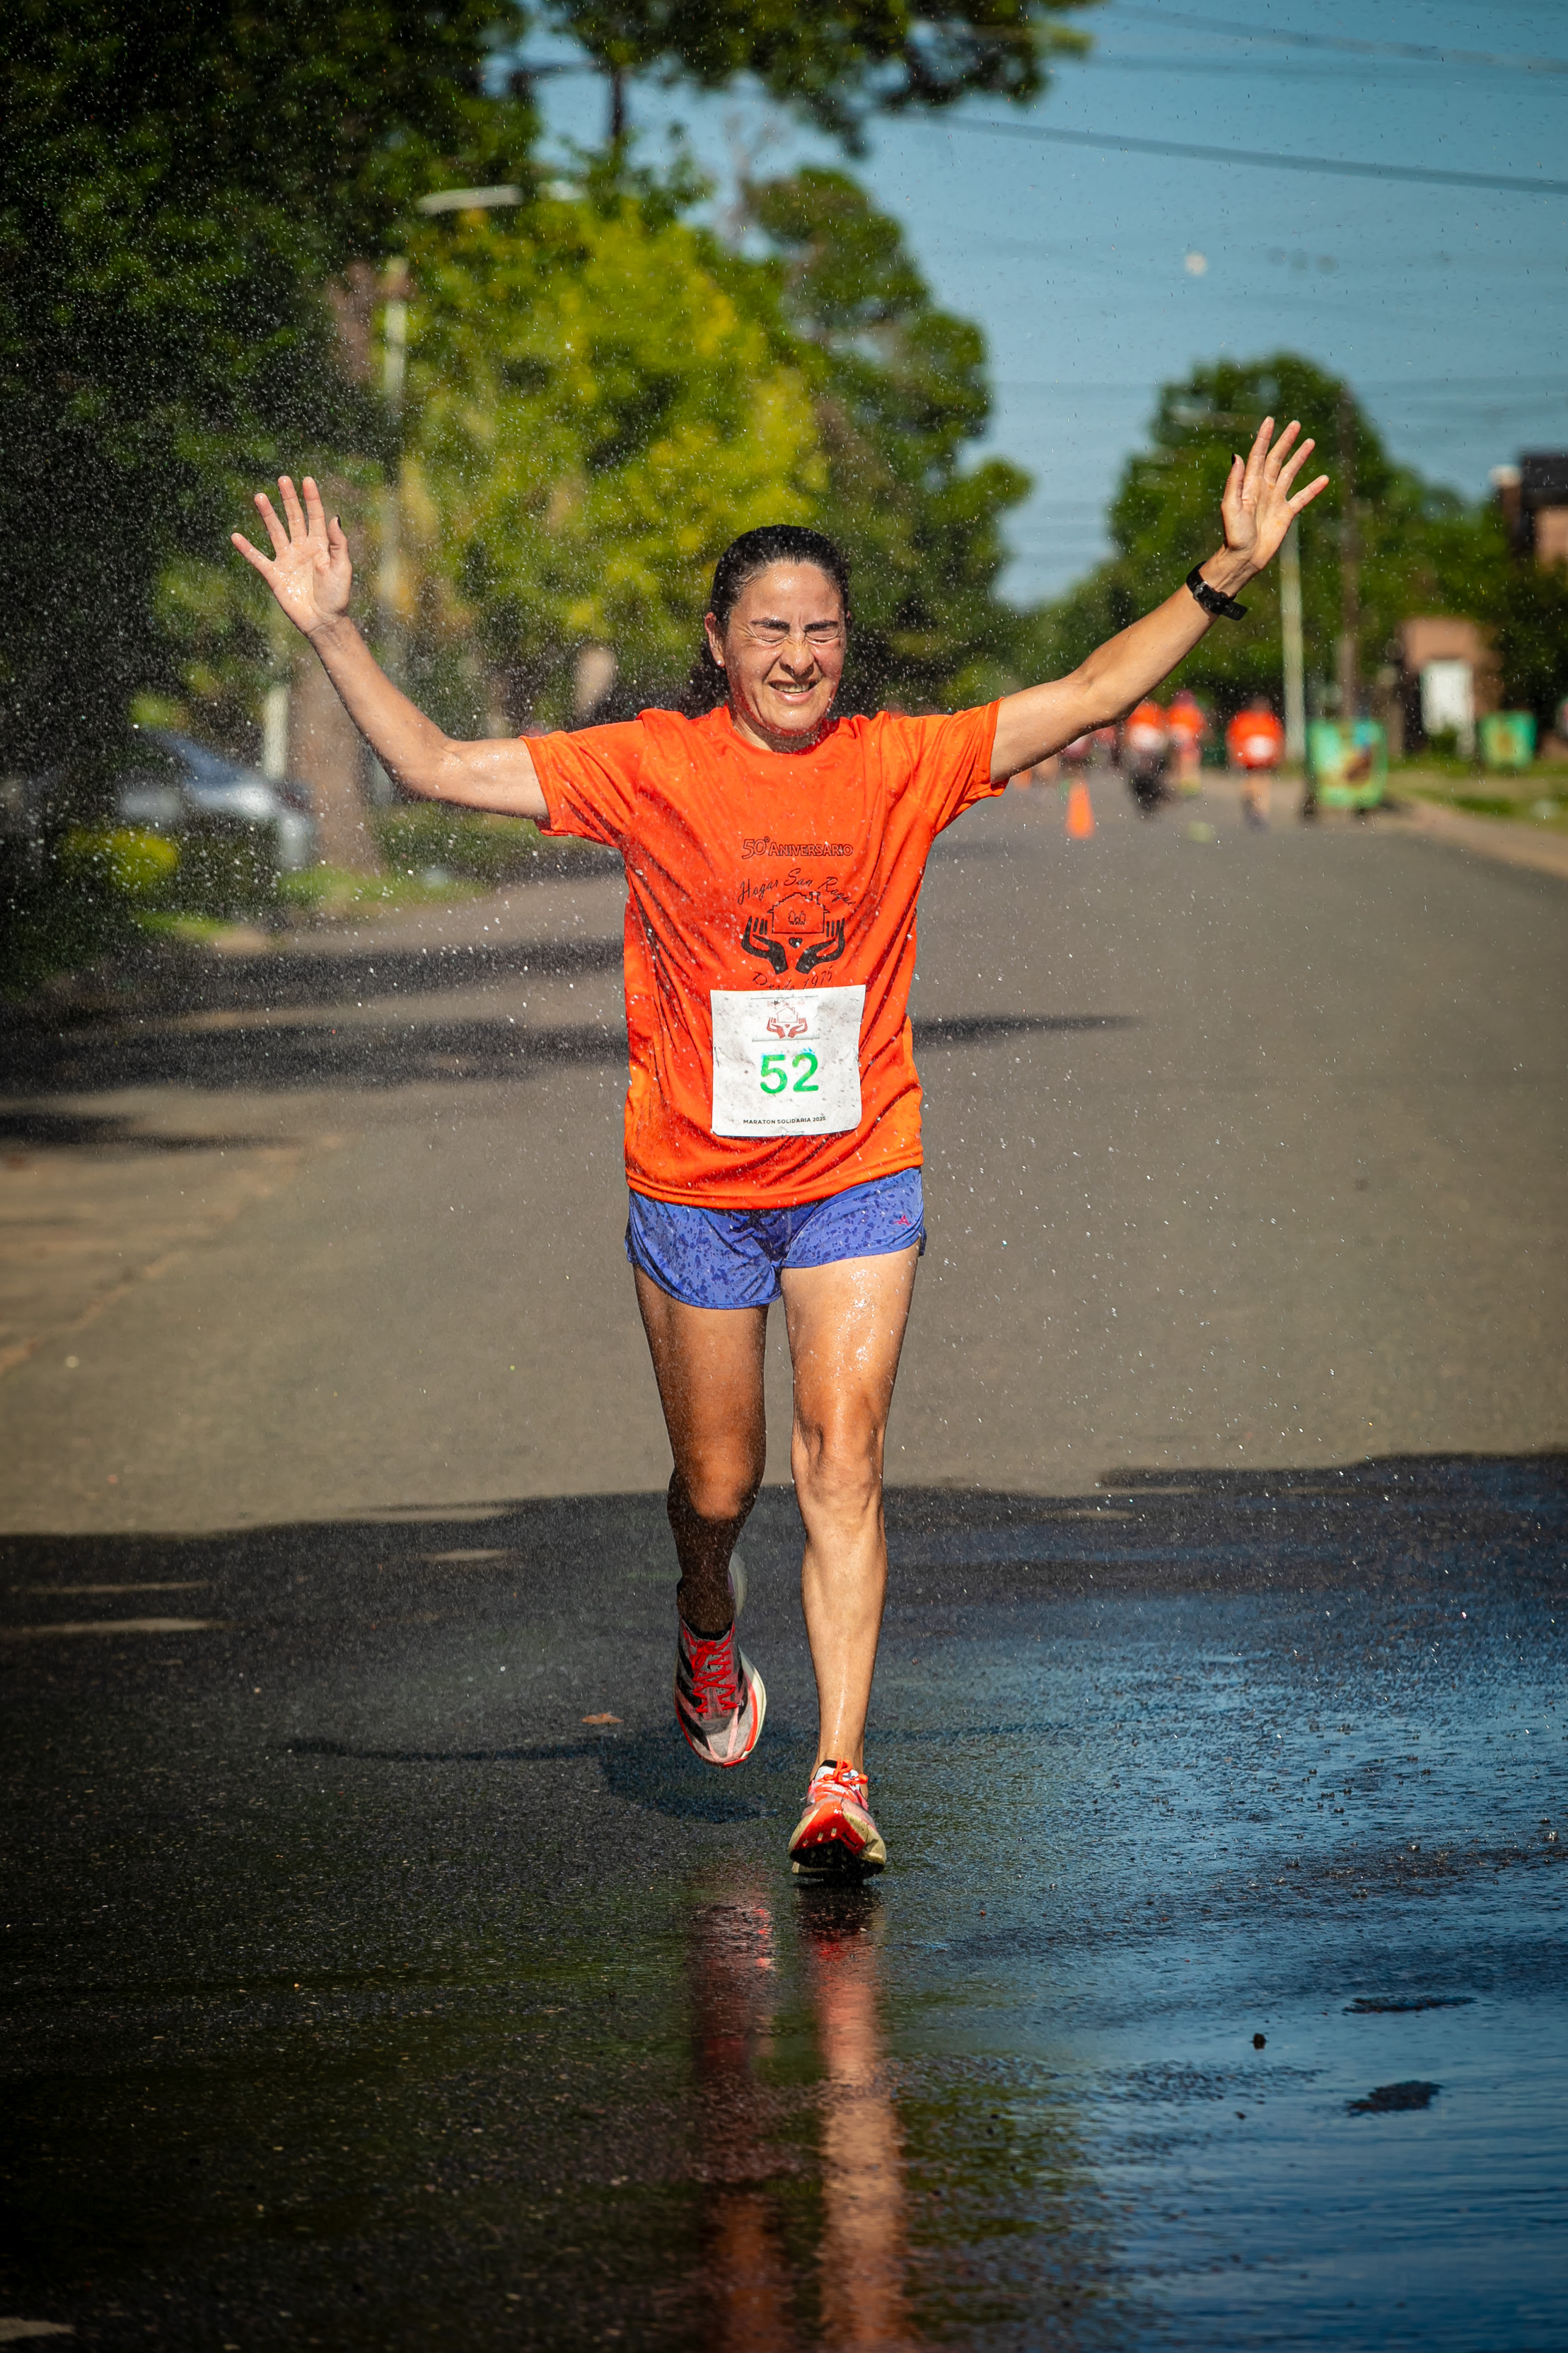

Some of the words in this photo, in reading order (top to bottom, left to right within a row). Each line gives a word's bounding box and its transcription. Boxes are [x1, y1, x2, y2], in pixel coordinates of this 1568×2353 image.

[768, 842, 853, 857] ANIVERSARIO
[738, 879, 779, 905] Hogar
[784, 868, 813, 886] San
[818, 877, 856, 906] Roque
[803, 966, 833, 990] 1975
[760, 1052, 819, 1094] 52
